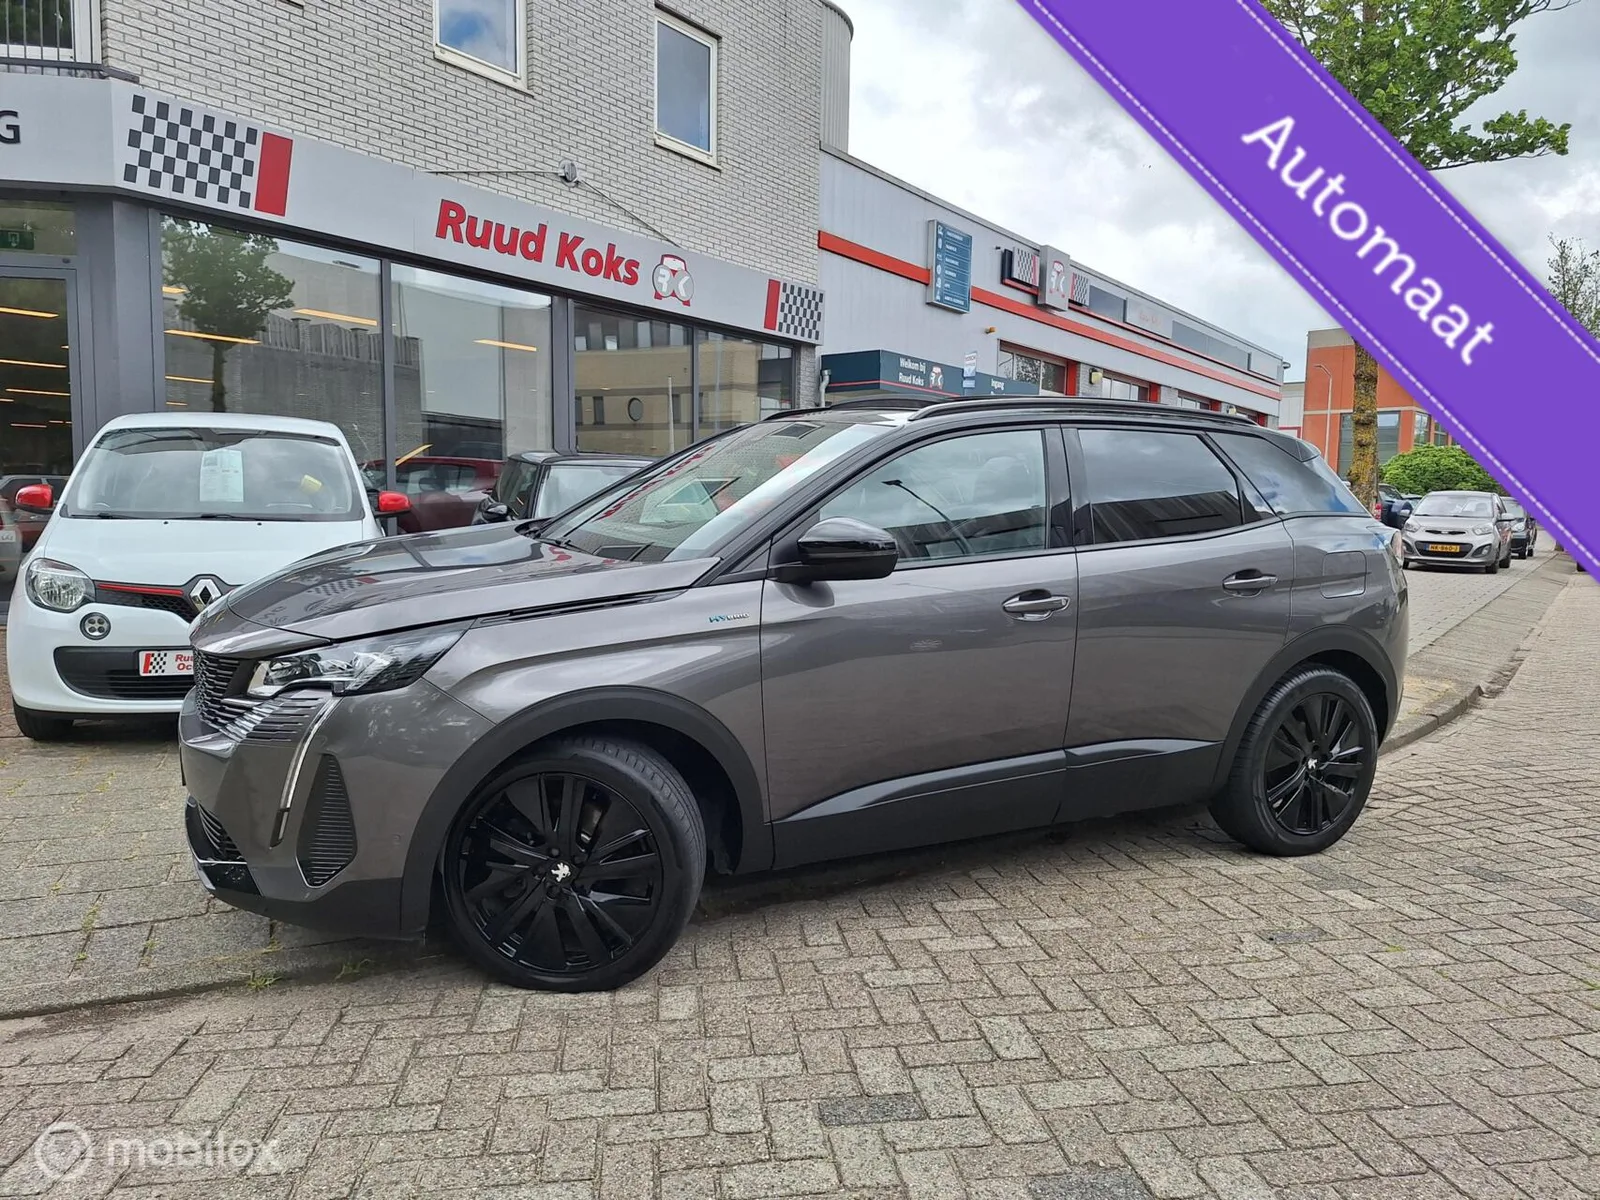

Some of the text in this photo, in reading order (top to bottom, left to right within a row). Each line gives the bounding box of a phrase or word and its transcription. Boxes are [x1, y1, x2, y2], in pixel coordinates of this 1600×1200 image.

[435, 199, 640, 287] Ruud Koks
[899, 357, 919, 371] Welkom
[898, 371, 925, 387] Ruud Koks
